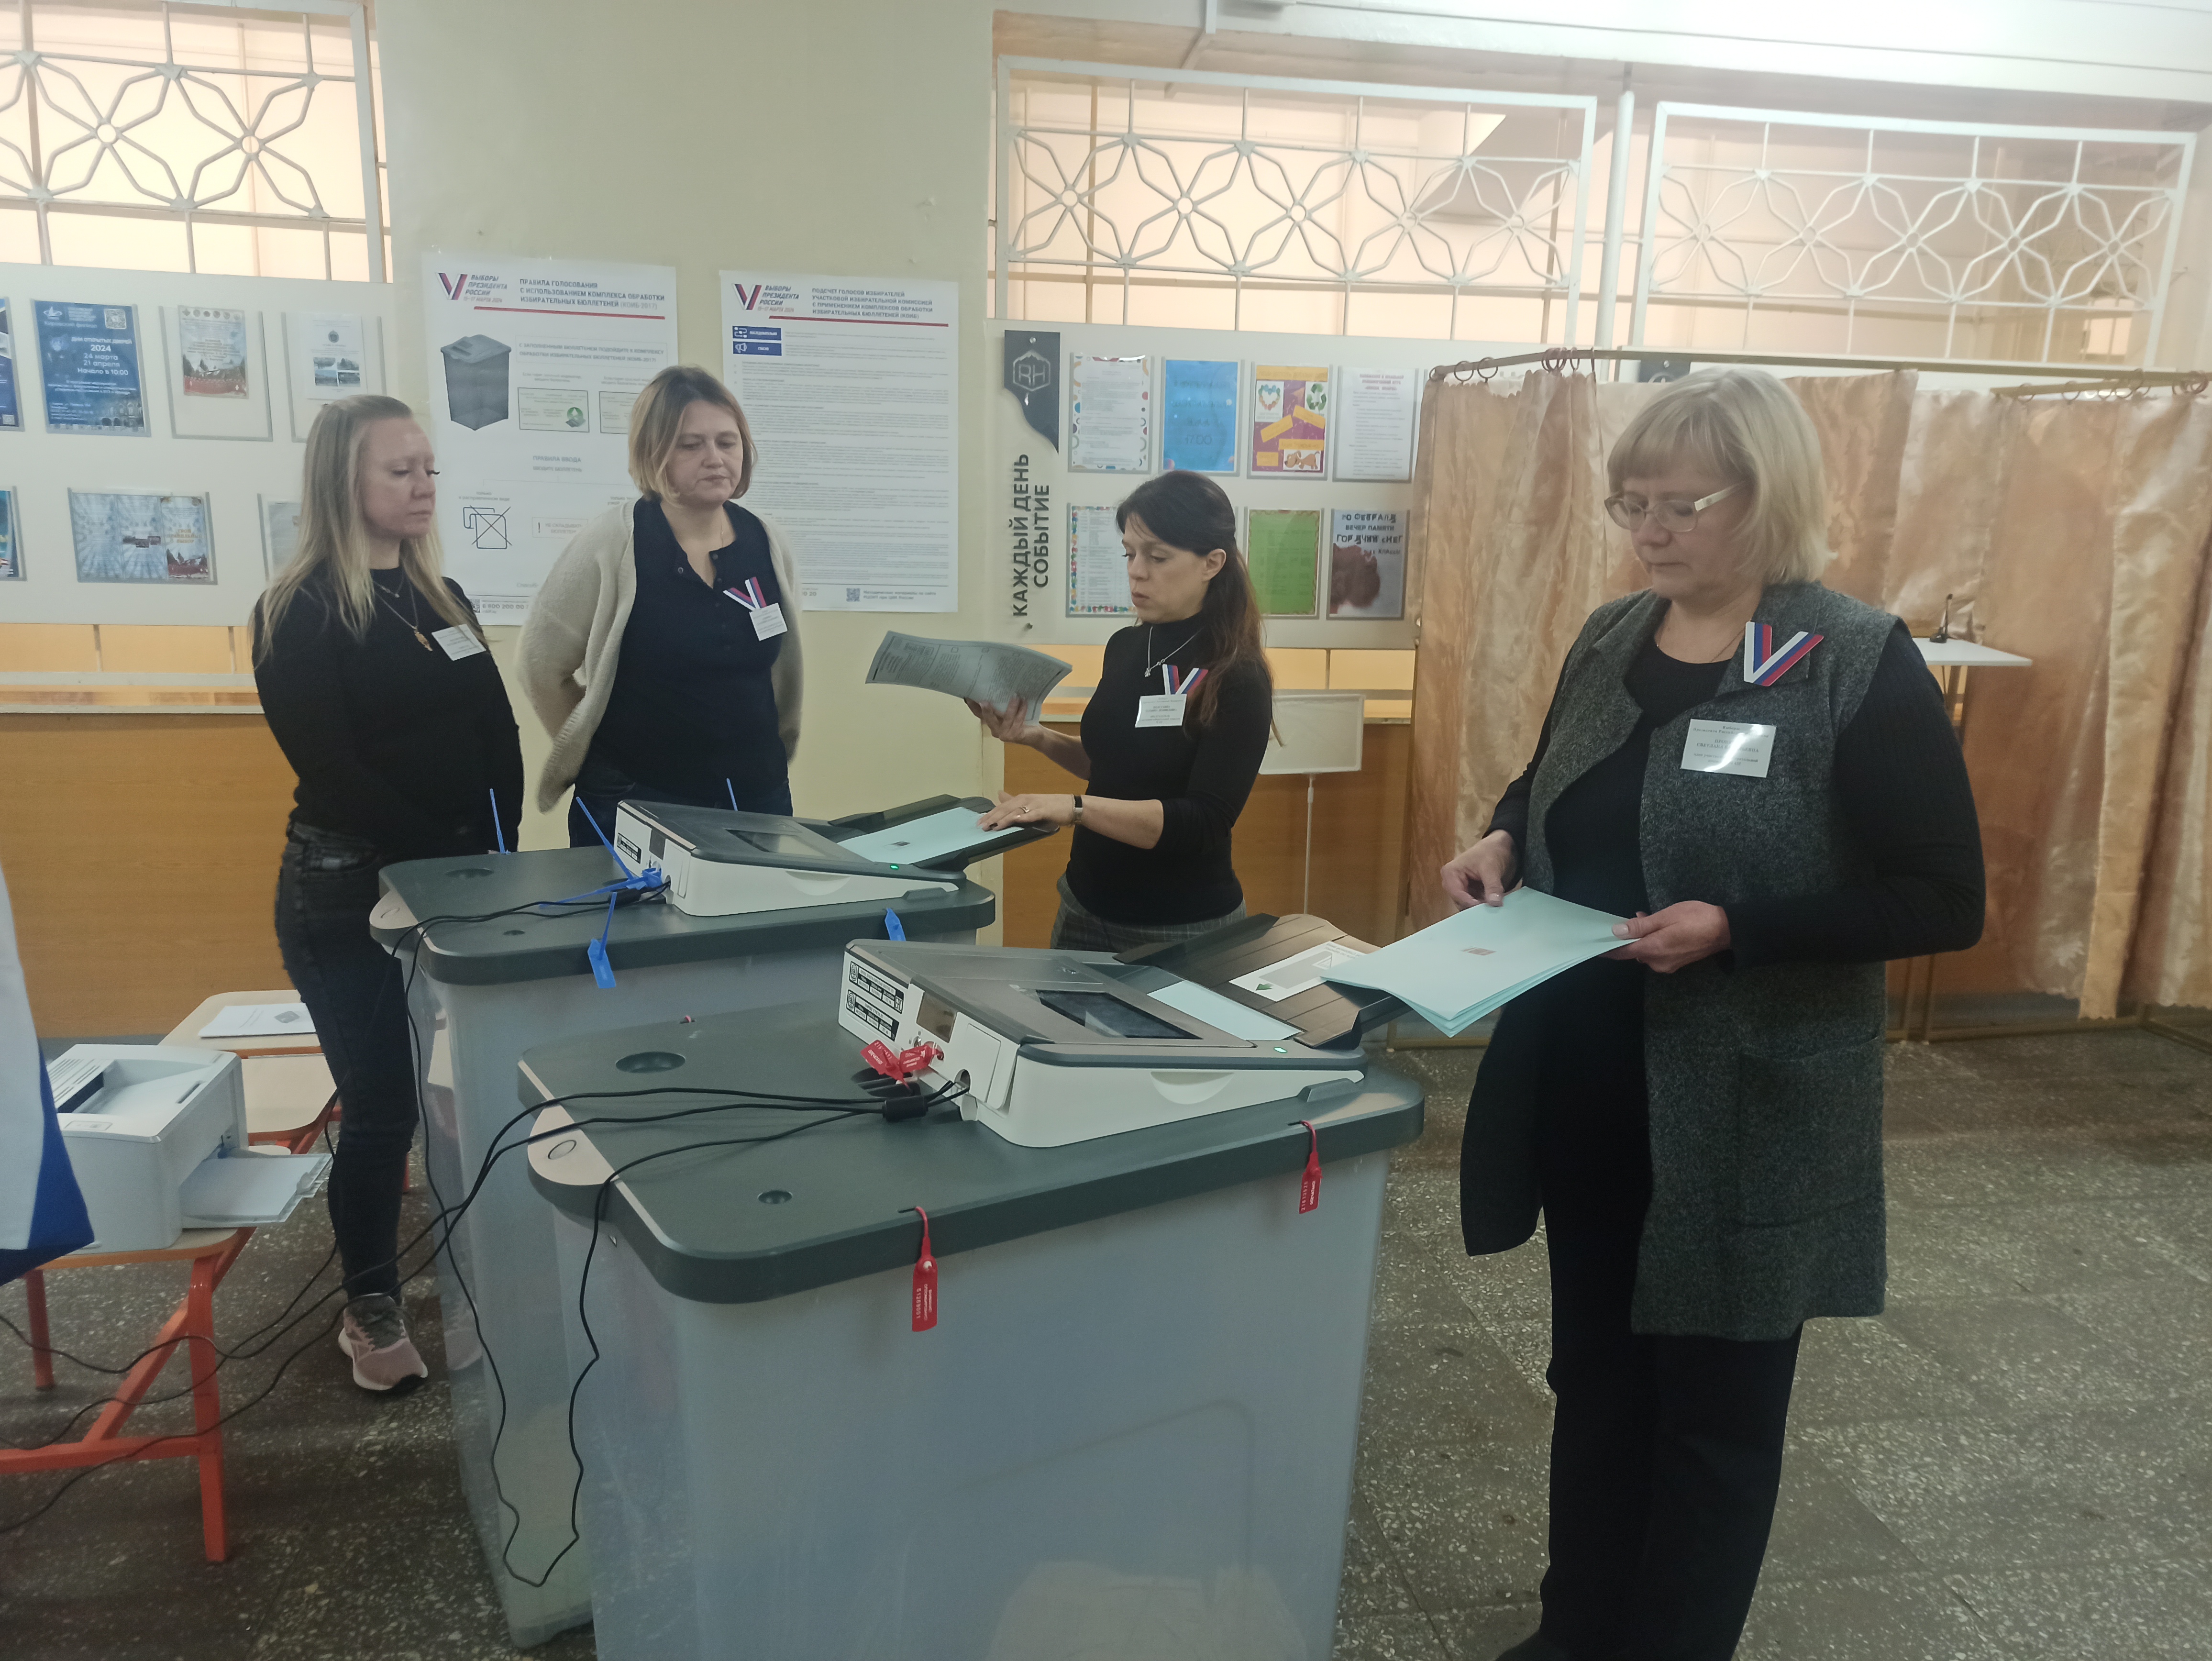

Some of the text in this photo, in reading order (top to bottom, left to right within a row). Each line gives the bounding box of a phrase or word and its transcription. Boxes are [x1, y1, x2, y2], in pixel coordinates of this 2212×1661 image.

[551, 280, 598, 288] ГОЛОСОВАНИЯ
[526, 288, 586, 297] ИСПОЛЬЗОВАНИЕМ
[520, 297, 575, 305] ИЗБИРАТЕЛЬНЫХ
[1008, 454, 1031, 616] КАЖДЫЙ ДЕНЬ
[1033, 485, 1050, 588] СОБЫТИЕ
